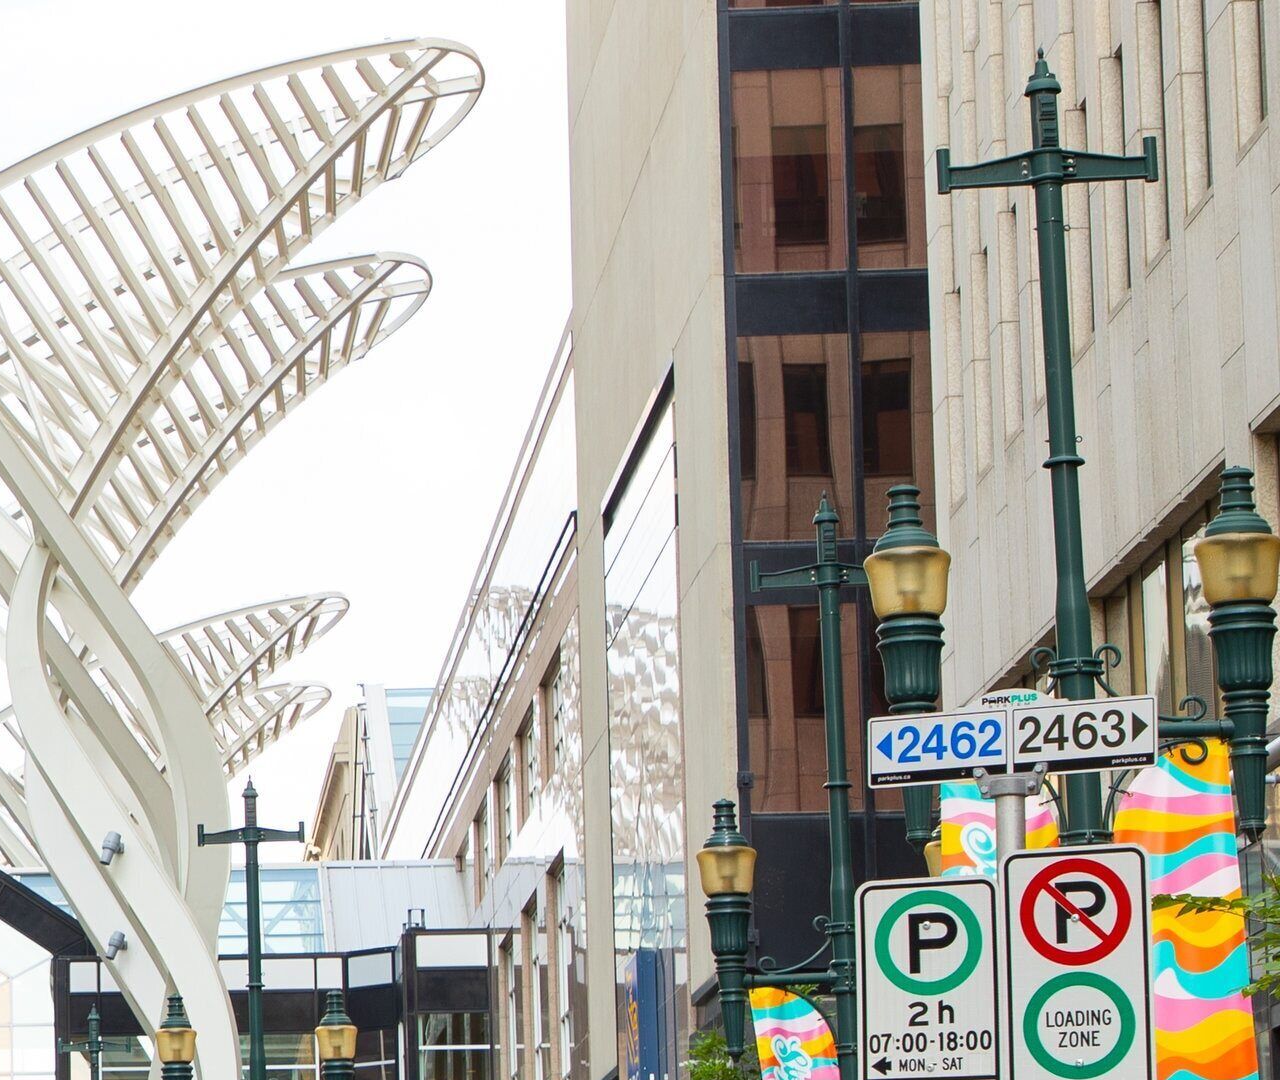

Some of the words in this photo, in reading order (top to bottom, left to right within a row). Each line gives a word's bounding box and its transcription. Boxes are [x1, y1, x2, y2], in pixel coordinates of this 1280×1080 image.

[897, 718, 1003, 764] 2462
[1018, 709, 1126, 754] 2463
[1111, 755, 1147, 765] parkplus.ca
[877, 774, 911, 783] parkplus.ca
[908, 911, 958, 974] P
[908, 1001, 929, 1027] 2
[938, 1000, 955, 1024] h
[1045, 1009, 1112, 1028] LOADING
[869, 1030, 992, 1053] 07:00-18:00
[1058, 1031, 1101, 1048] ZONE
[899, 1058, 925, 1072] MON
[942, 1057, 964, 1071] SAT
